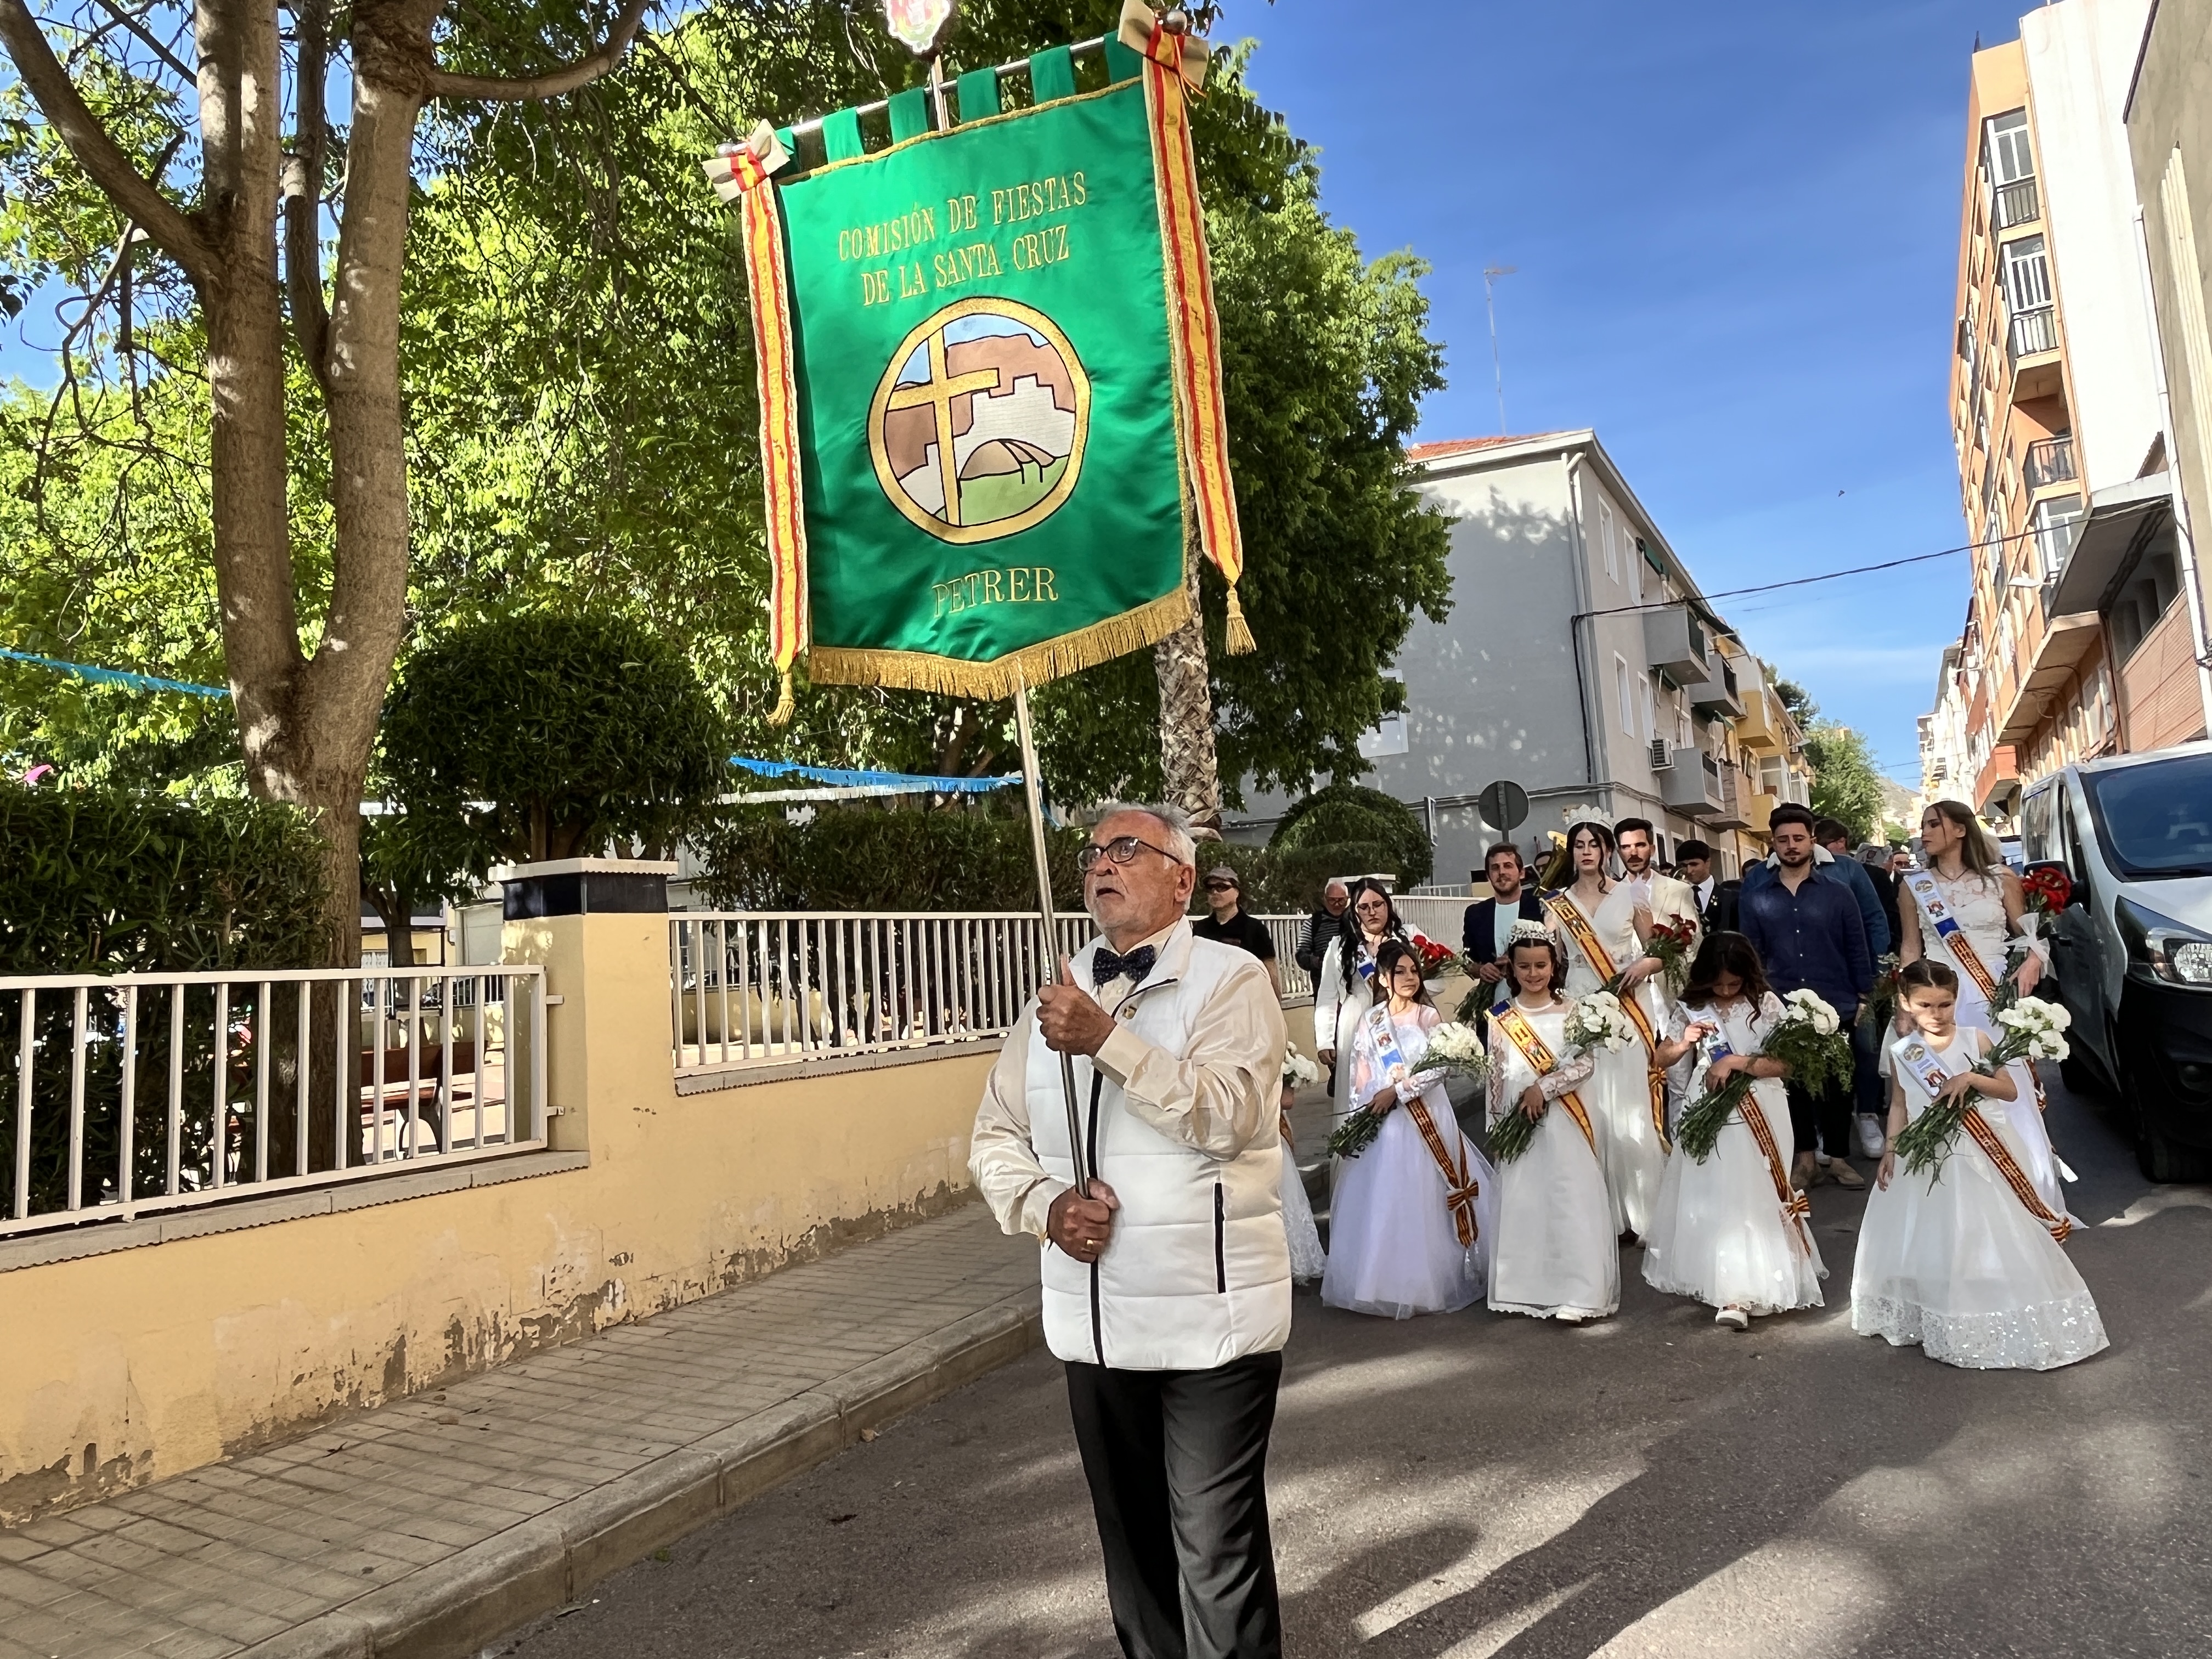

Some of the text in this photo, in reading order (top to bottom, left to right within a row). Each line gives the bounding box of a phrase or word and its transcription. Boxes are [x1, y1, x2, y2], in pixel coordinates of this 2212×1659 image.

[838, 171, 1087, 261] COMISIÓN DE FIESTAS
[861, 224, 1070, 306] DE LA SANTA CRUZ
[932, 567, 1059, 618] PETRER
